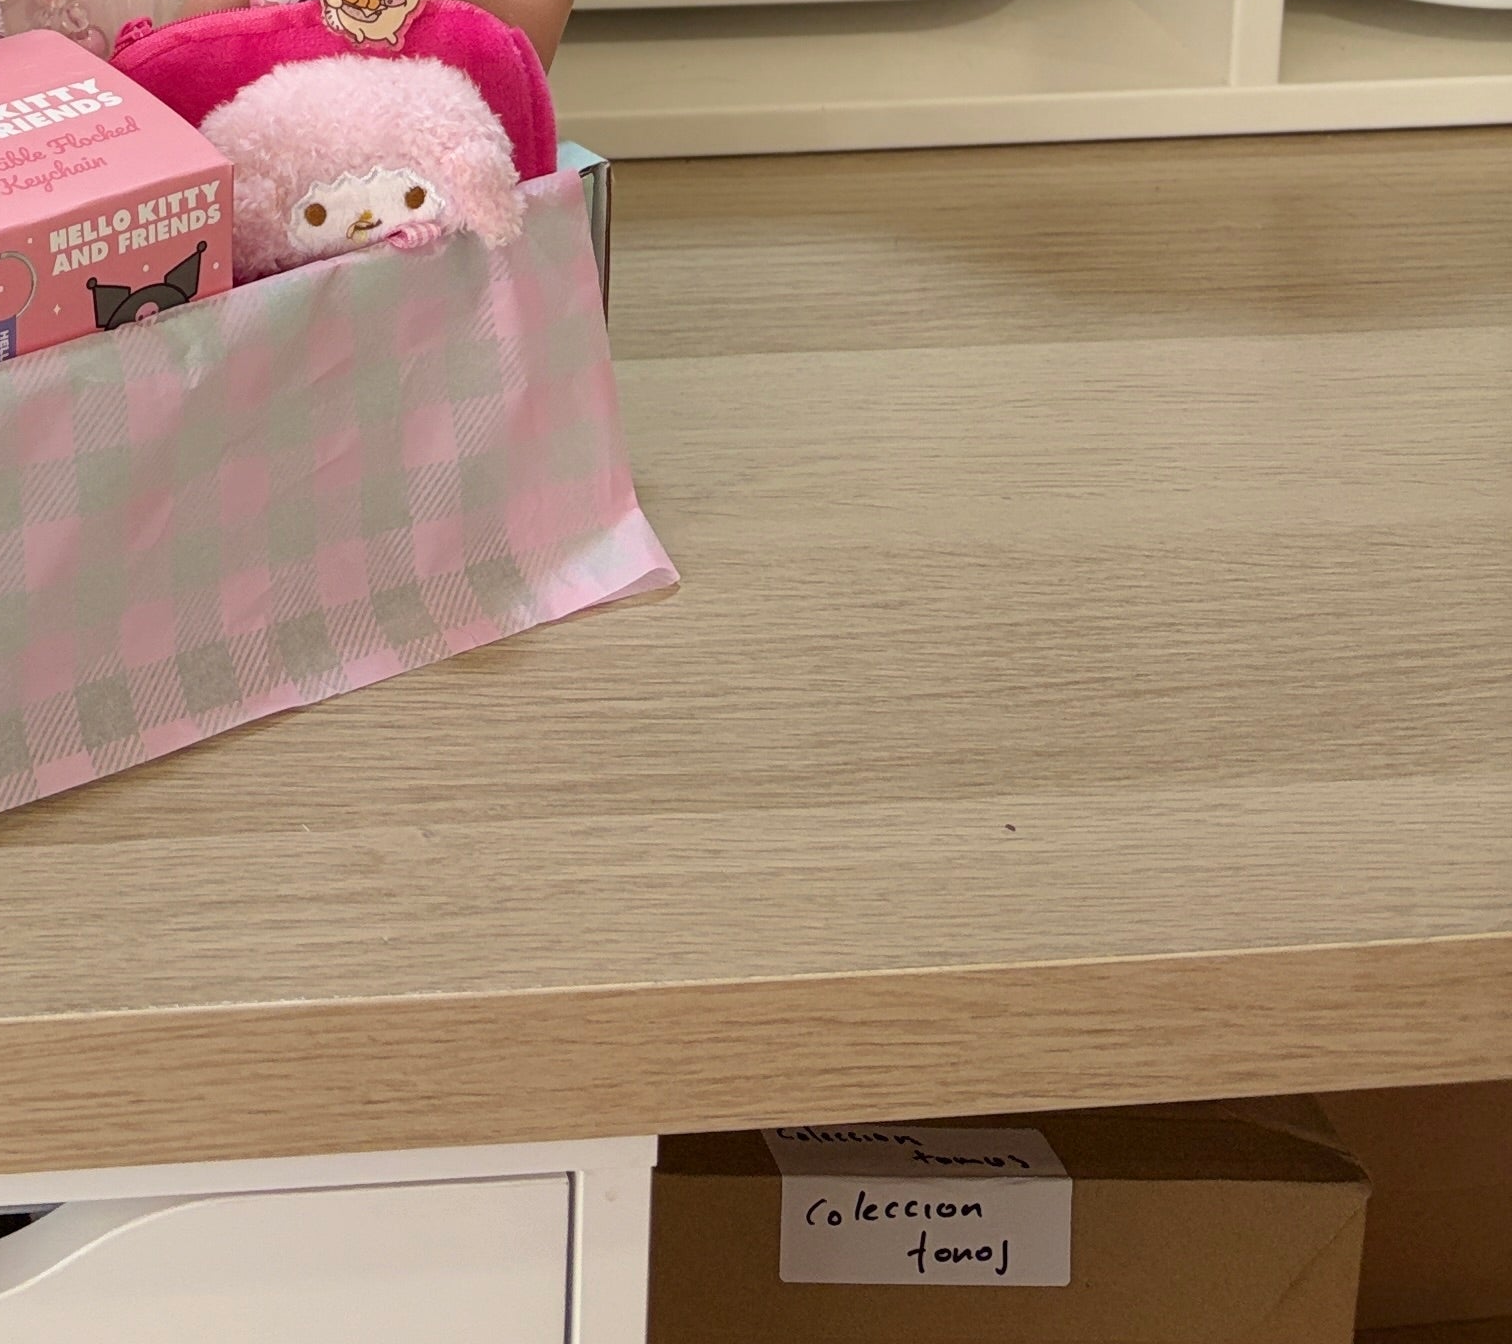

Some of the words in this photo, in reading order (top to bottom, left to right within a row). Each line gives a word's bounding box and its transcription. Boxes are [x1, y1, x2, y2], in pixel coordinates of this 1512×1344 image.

[46, 115, 141, 155] Flocked
[49, 208, 132, 253] HELLO
[137, 179, 221, 225] KITTY
[52, 240, 109, 276] AND
[118, 203, 221, 255] FRIENDS
[806, 1190, 983, 1226] Coleccion
